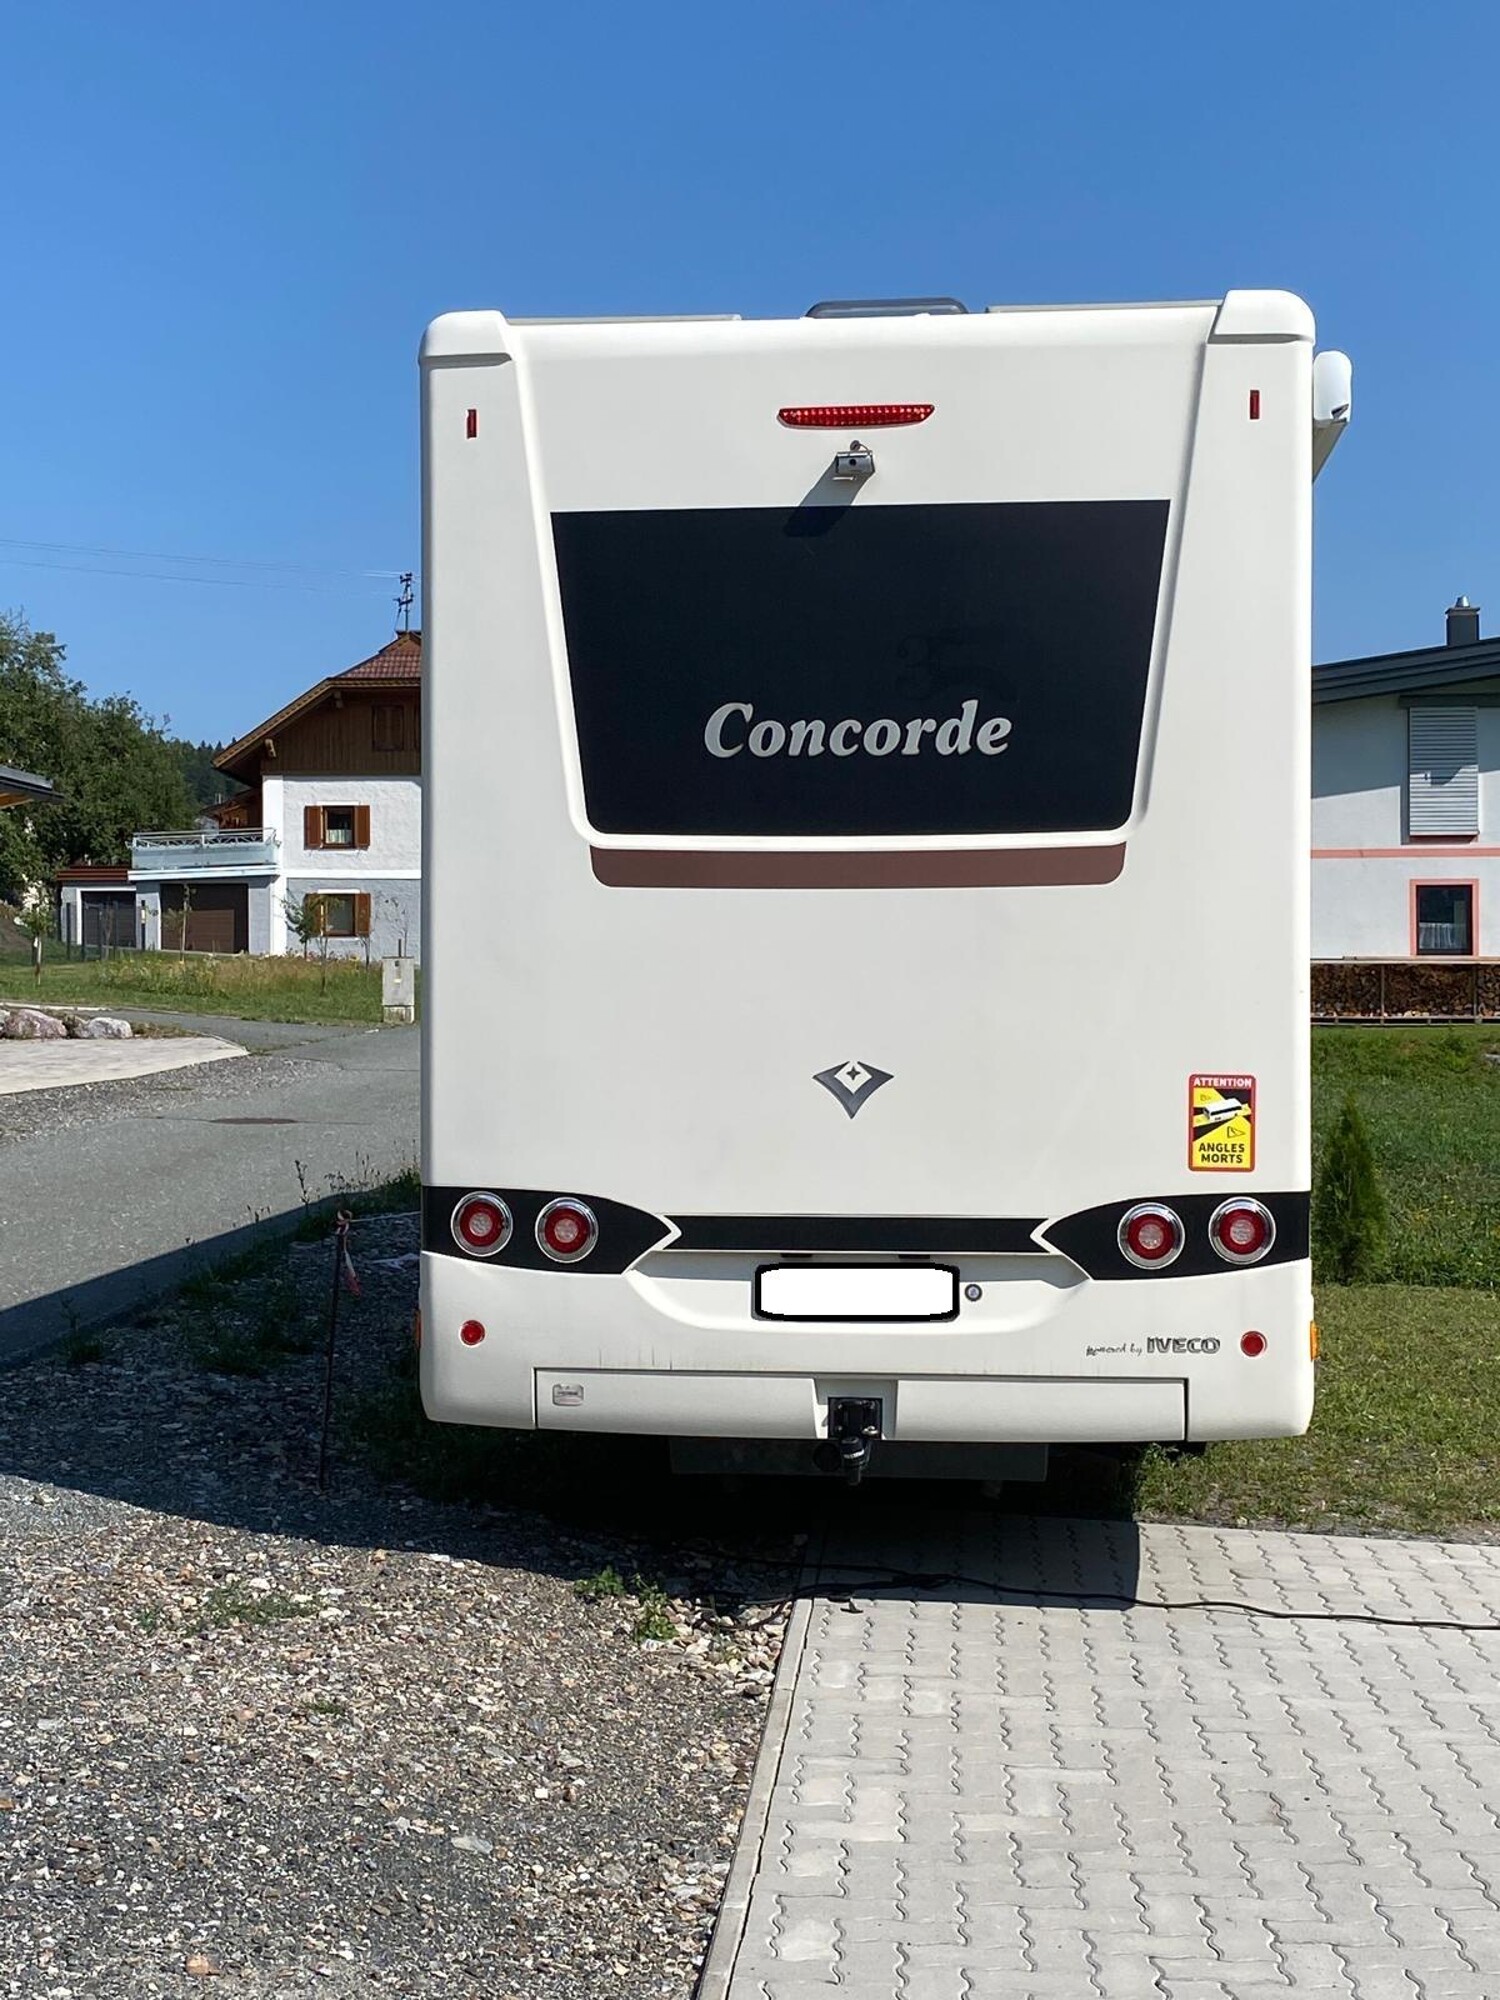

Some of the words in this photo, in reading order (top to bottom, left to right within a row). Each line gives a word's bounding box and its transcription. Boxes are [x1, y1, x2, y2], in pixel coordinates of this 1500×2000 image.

[704, 699, 1012, 758] Concorde
[1193, 1077, 1252, 1087] ATTENTION
[1198, 1142, 1245, 1153] ANGLES
[1200, 1154, 1243, 1164] MORTS
[1130, 1343, 1142, 1357] by
[1147, 1337, 1221, 1354] IVECO
